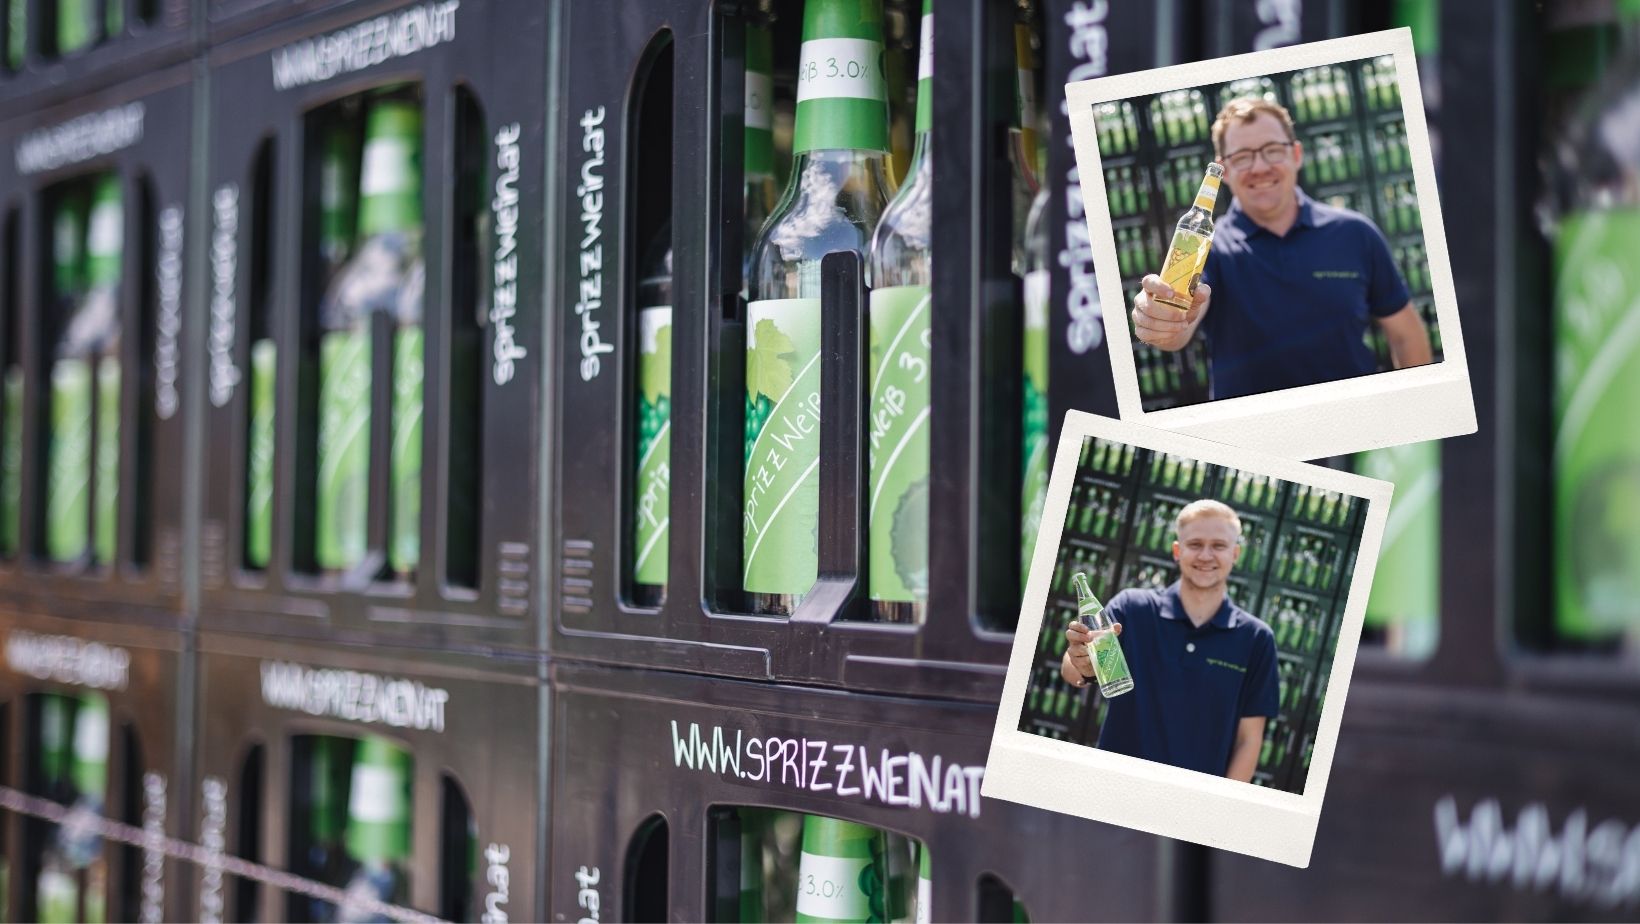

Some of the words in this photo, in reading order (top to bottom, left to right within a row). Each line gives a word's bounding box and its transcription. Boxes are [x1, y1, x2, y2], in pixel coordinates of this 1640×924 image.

[826, 58, 870, 79] 3.0%
[575, 105, 614, 382] sprizzwein.at
[671, 720, 985, 818] WWW.SPRIZZWEIN.AT
[806, 875, 845, 899] 3.0%
